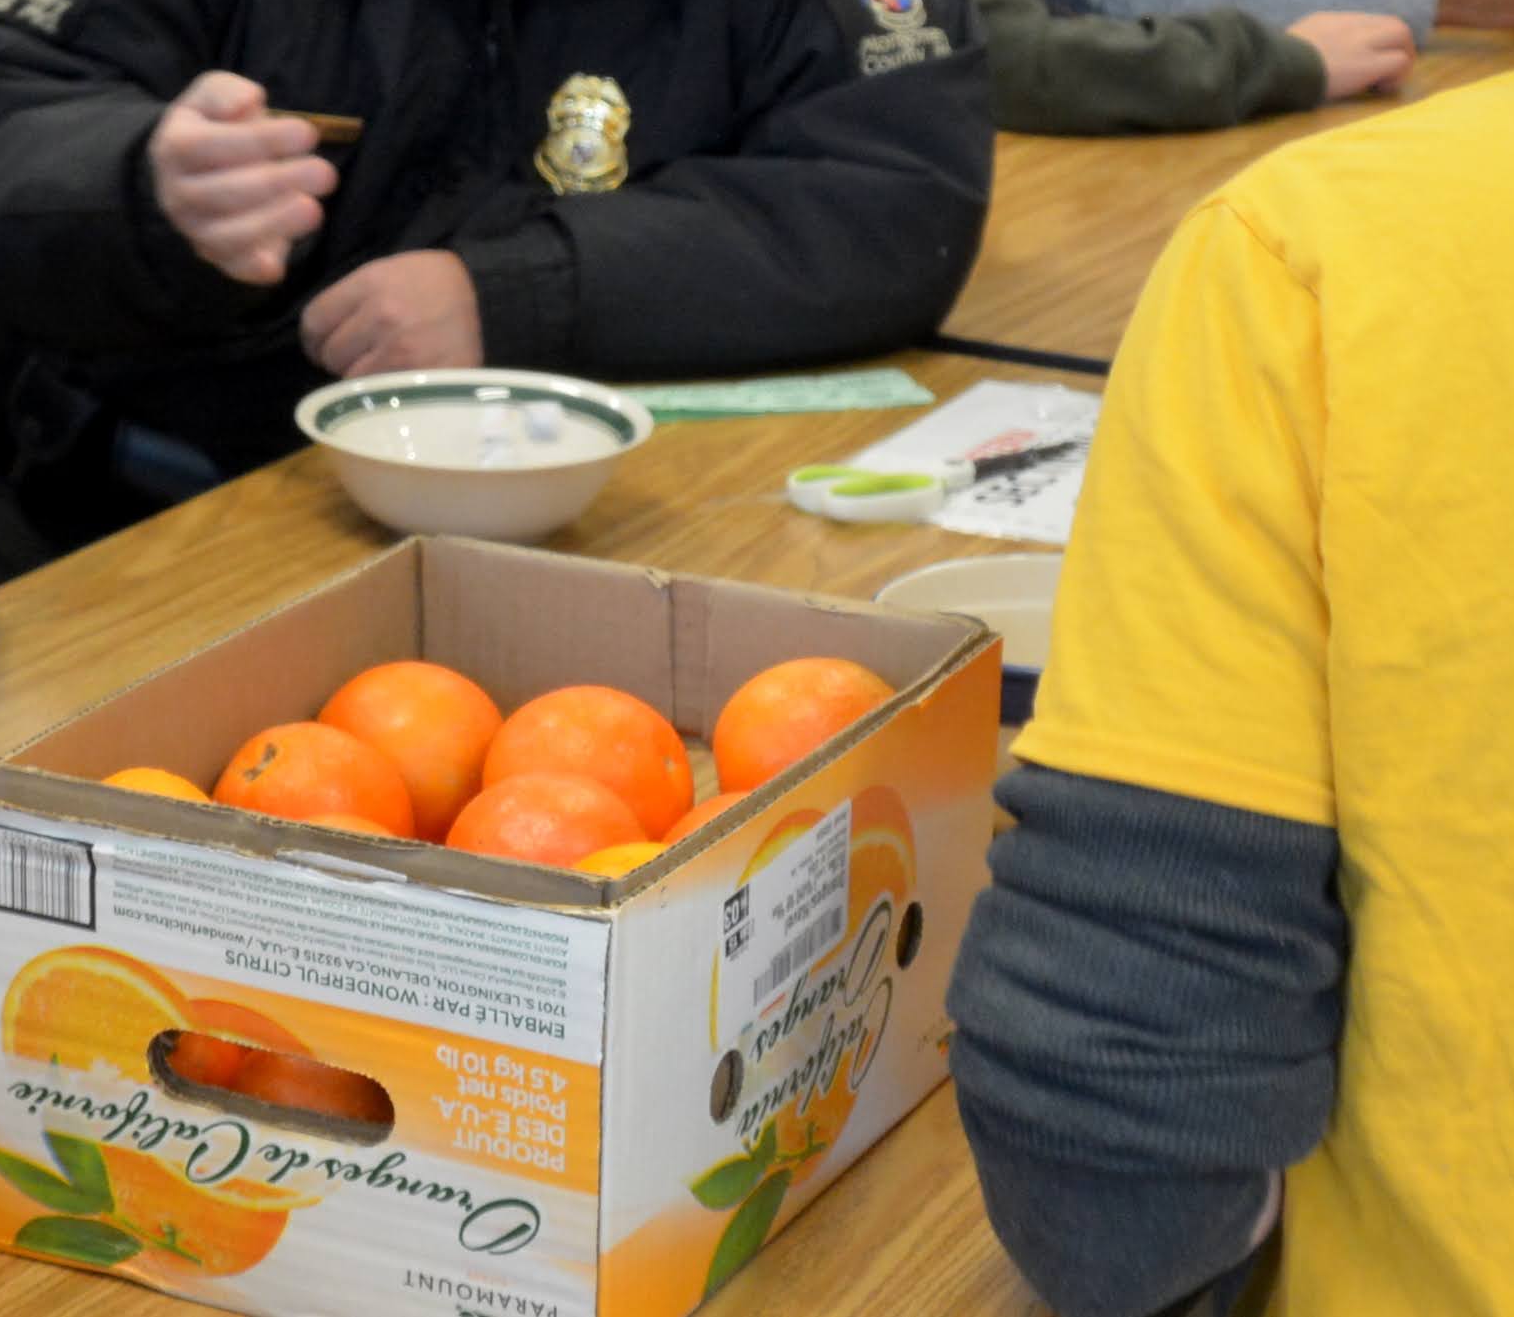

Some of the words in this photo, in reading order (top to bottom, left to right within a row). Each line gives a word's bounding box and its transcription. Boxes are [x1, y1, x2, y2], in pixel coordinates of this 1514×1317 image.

[113, 905, 244, 945] wonderfulcitrus.com
[224, 948, 290, 977] CITRUS
[344, 957, 363, 972] CA
[366, 960, 429, 986] DELANO,
[298, 965, 418, 1005] WONDERFUL
[433, 975, 519, 1006] LEXINGTON,
[749, 901, 892, 1063] Oranges
[432, 995, 469, 1016] PAR
[522, 996, 534, 1009] S.
[537, 1000, 565, 1016] 1701
[475, 1004, 565, 1038] EMBALLÉ
[436, 1042, 458, 1070] lb
[462, 1049, 488, 1077] 10
[494, 1052, 524, 1084] kg
[736, 975, 893, 1140] California
[457, 1074, 494, 1100] net
[529, 1065, 568, 1095] 4.5
[500, 1083, 566, 1121] Poids
[9, 1080, 251, 1182] Californie
[515, 1114, 565, 1148] DES
[259, 1145, 310, 1182] de
[452, 1125, 565, 1173] PRODUIT
[322, 1153, 541, 1255] Oranges
